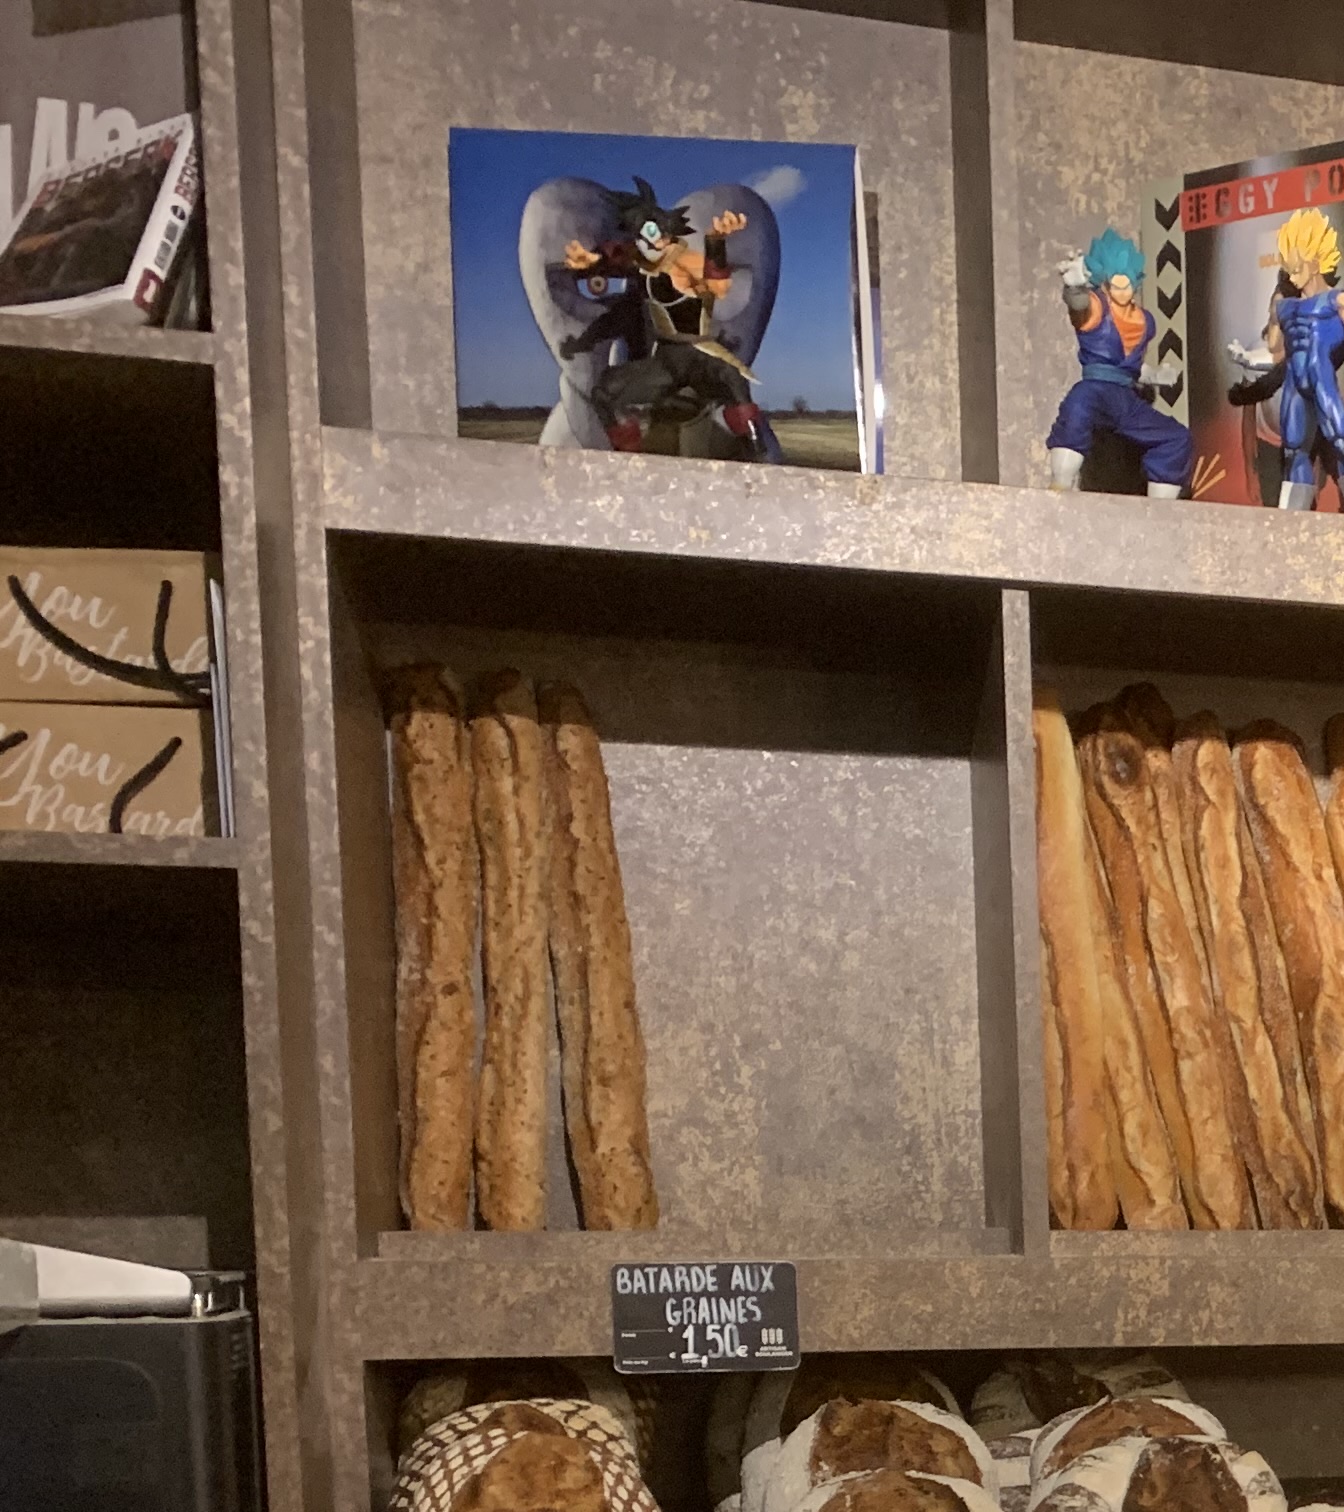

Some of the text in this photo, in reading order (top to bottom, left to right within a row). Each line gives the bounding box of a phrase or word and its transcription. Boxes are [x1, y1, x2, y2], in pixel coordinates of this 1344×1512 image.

[616, 1265, 775, 1294] BATARDE AUX
[665, 1296, 762, 1326] GRAINES
